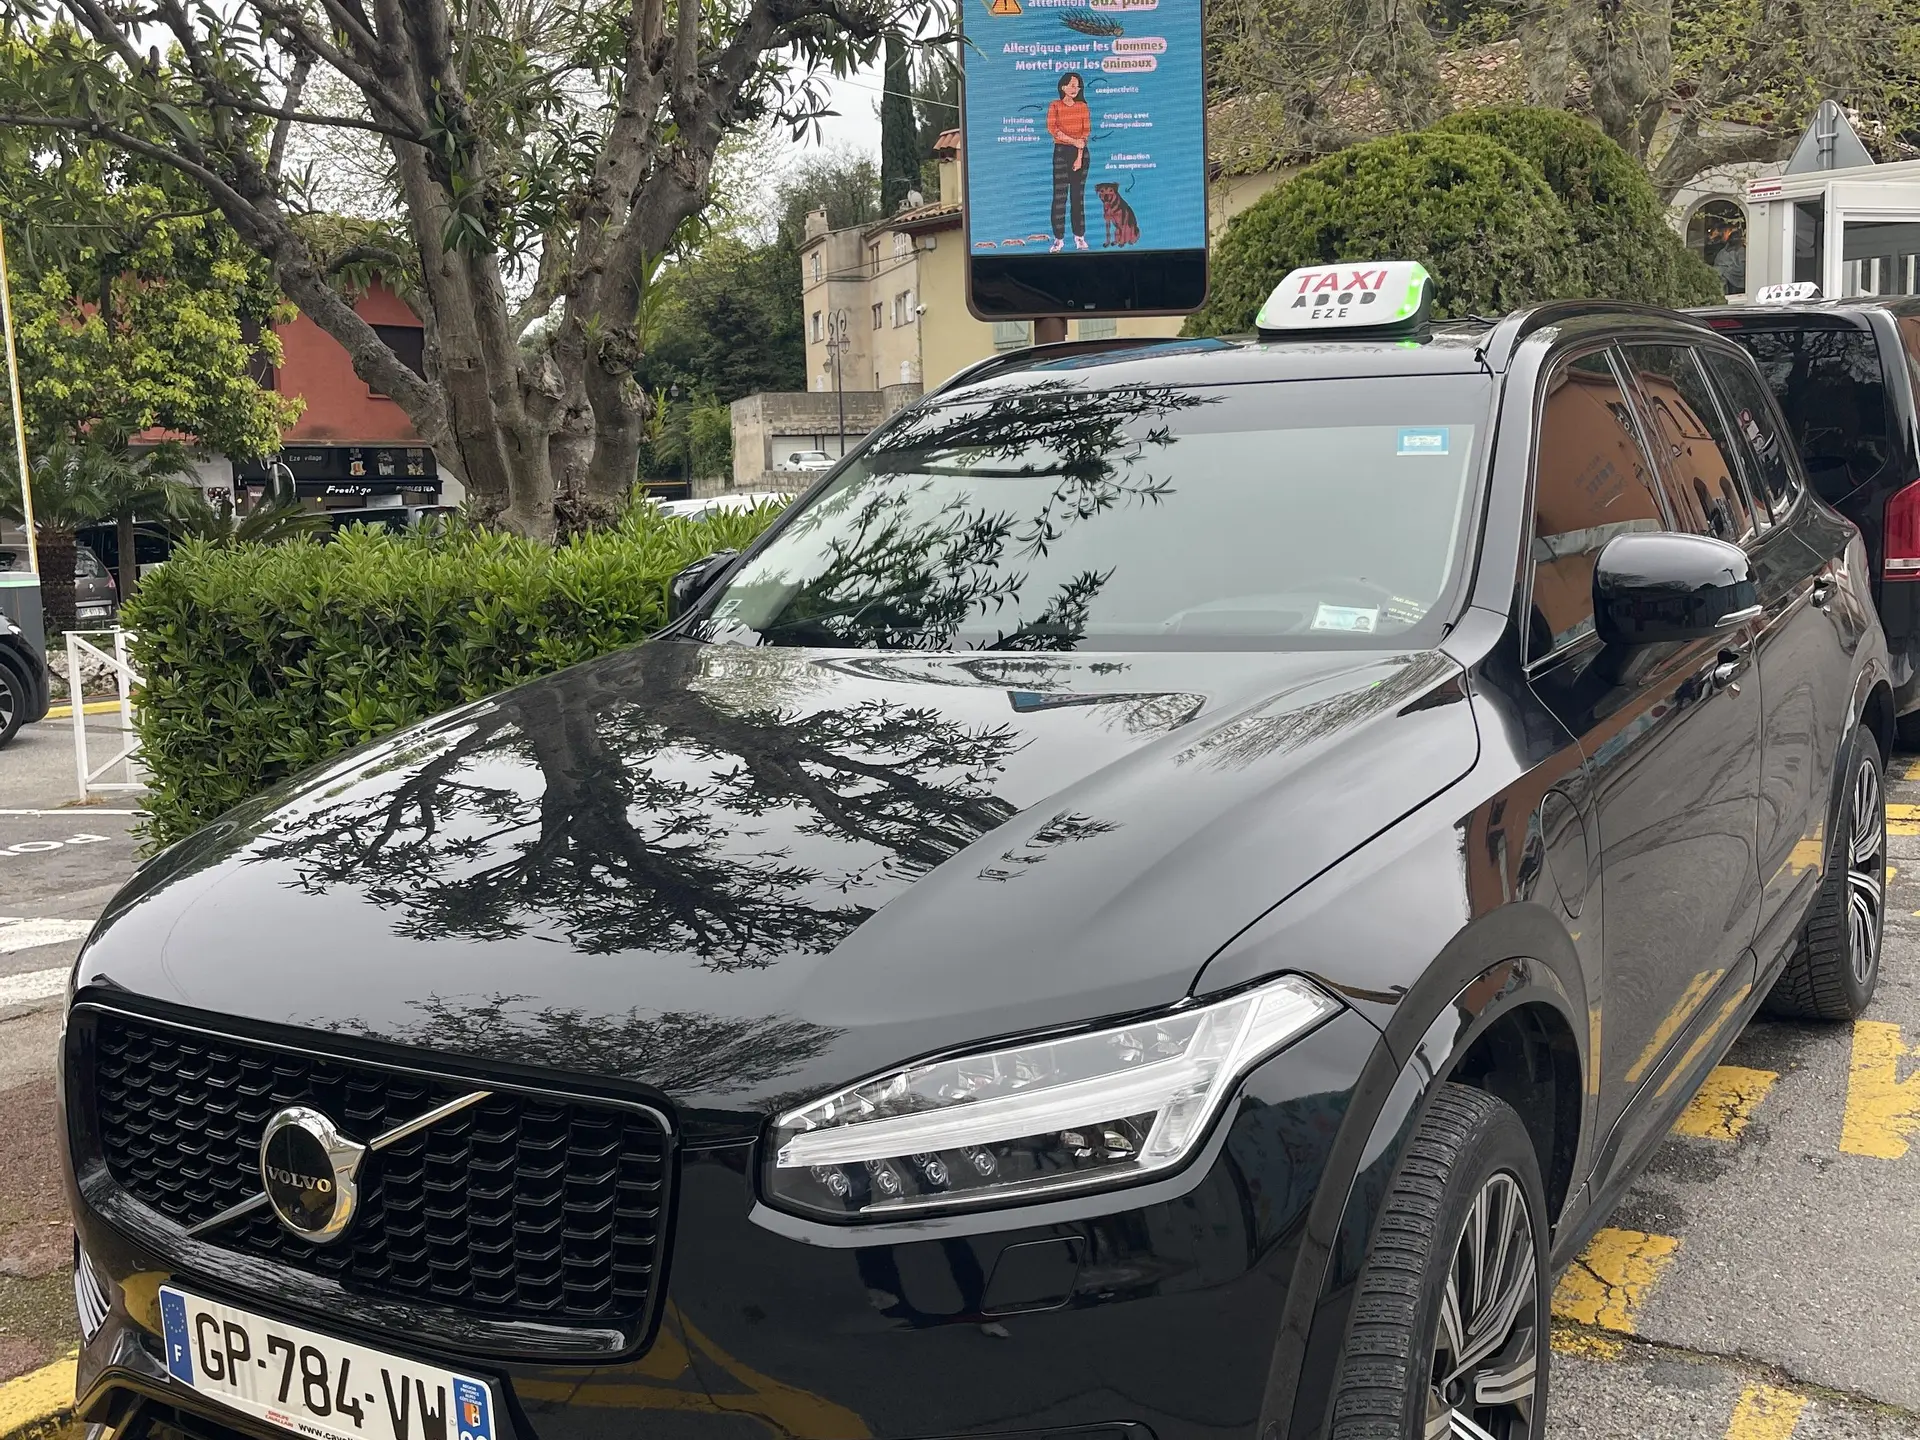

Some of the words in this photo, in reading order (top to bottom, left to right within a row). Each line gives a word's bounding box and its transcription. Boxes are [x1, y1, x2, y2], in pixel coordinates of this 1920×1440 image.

[1002, 42, 1061, 55] Allergique
[1064, 43, 1090, 54] pour
[1093, 41, 1109, 51] les
[1115, 40, 1164, 51] hommes
[1015, 60, 1052, 70] Mortel
[1055, 60, 1081, 72] pour
[1083, 57, 1099, 69] les
[1103, 58, 1152, 68] animaux
[1297, 270, 1388, 295] TAXI
[1311, 307, 1349, 319] EZE
[266, 1165, 332, 1193] VOLVO
[174, 1343, 183, 1362] F
[196, 1312, 448, 1440] GP-784-VW
